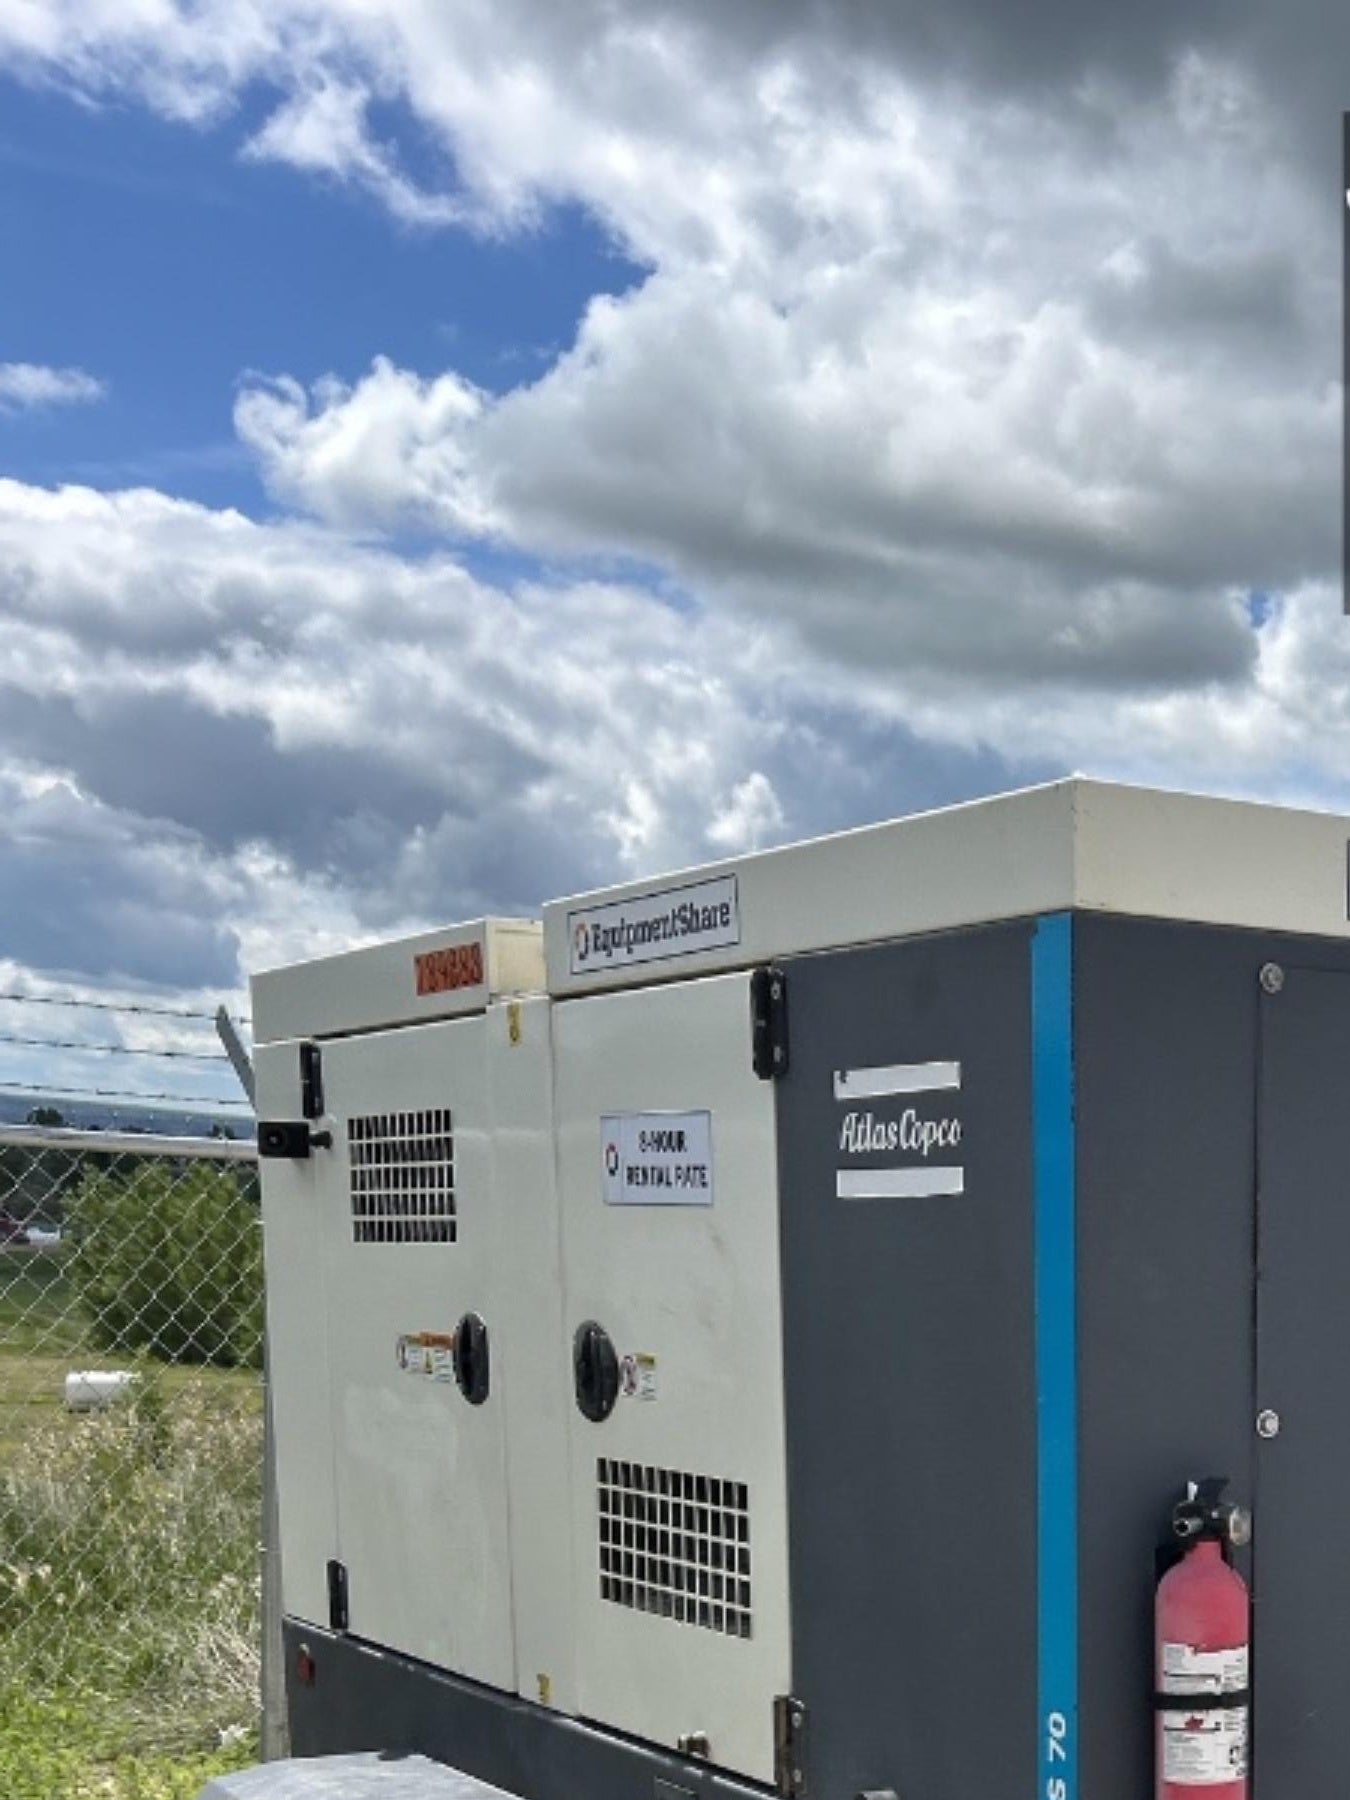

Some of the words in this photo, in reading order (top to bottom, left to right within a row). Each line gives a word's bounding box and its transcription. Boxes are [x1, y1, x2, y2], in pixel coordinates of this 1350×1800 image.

[591, 901, 731, 957] EquipmentShare
[840, 1111, 898, 1153] Atlas
[899, 1108, 961, 1157] Copco
[1047, 1712, 1067, 1762] 70
